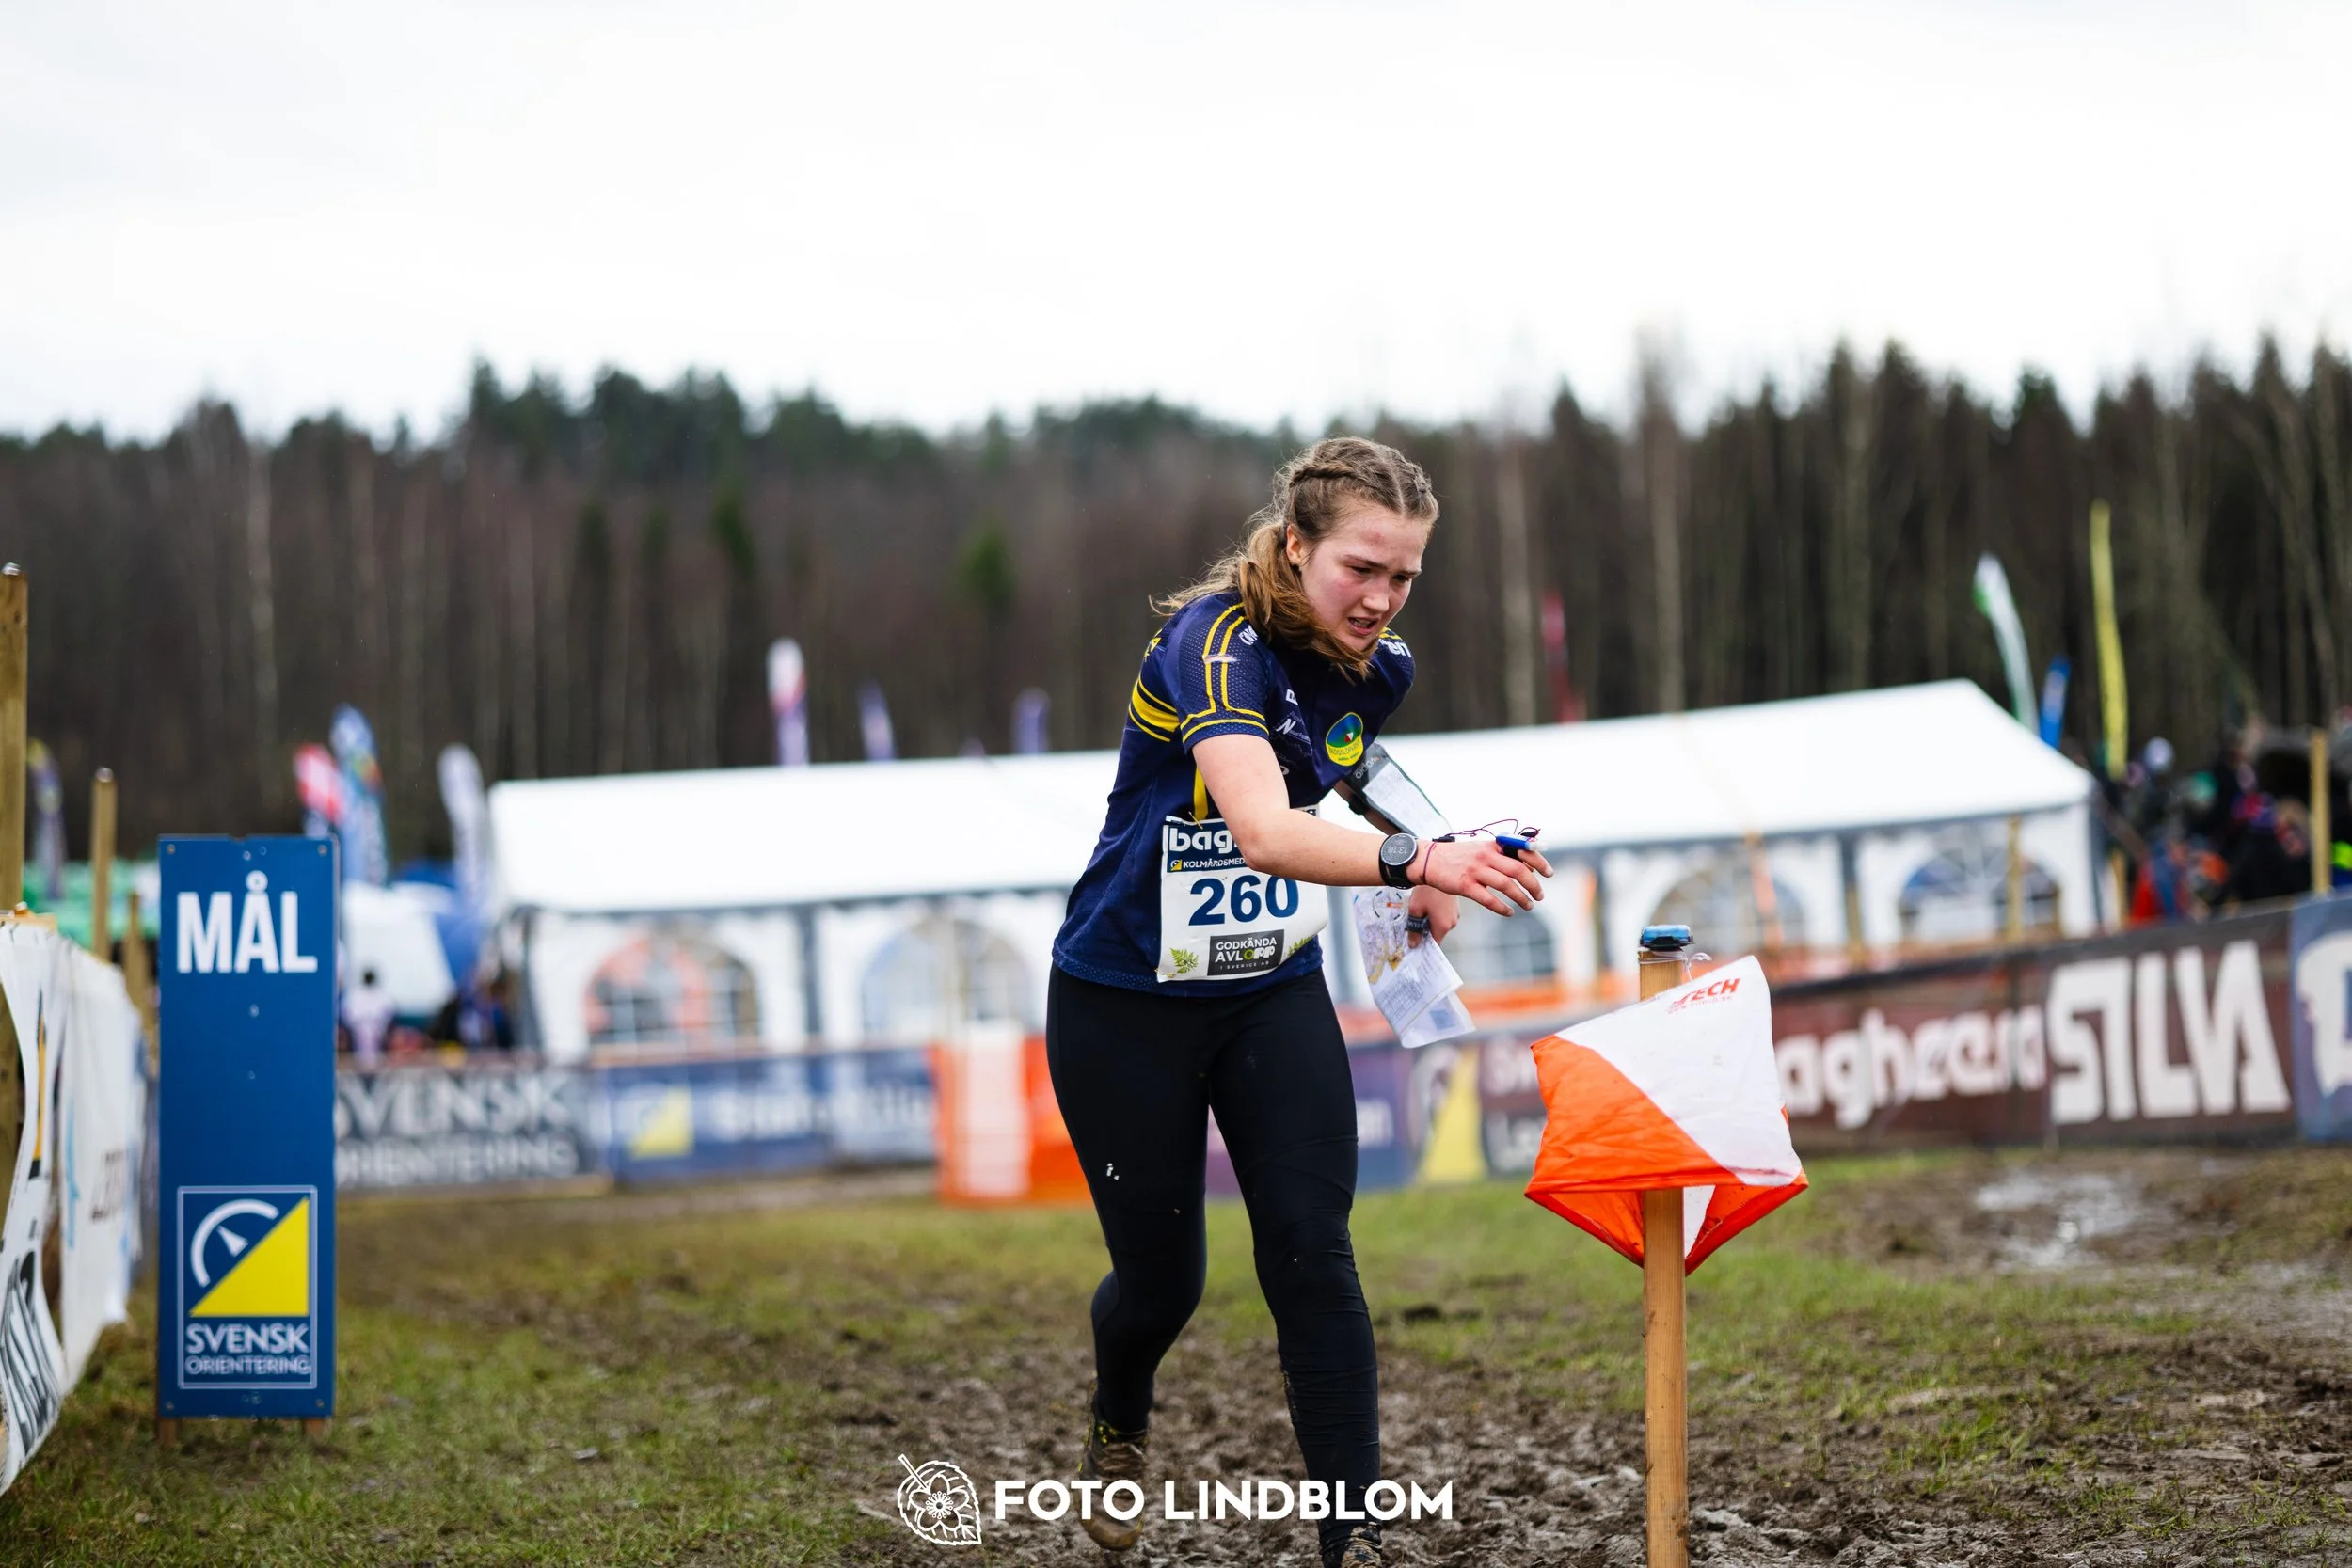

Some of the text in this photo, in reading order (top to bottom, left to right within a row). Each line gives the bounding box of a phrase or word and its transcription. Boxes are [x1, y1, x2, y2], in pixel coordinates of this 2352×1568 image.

[1169, 827, 1239, 855] bag
[1183, 857, 1247, 869] KOLMÅRDSMED
[1188, 874, 1299, 927] 260
[177, 870, 318, 974] MÅL
[1216, 937, 1277, 951] GODKÄNDA
[2047, 940, 2291, 1124] SILVA
[1774, 1005, 2048, 1129] agheera
[186, 1323, 309, 1354] SVENSK
[185, 1355, 311, 1375] ORIENTERING
